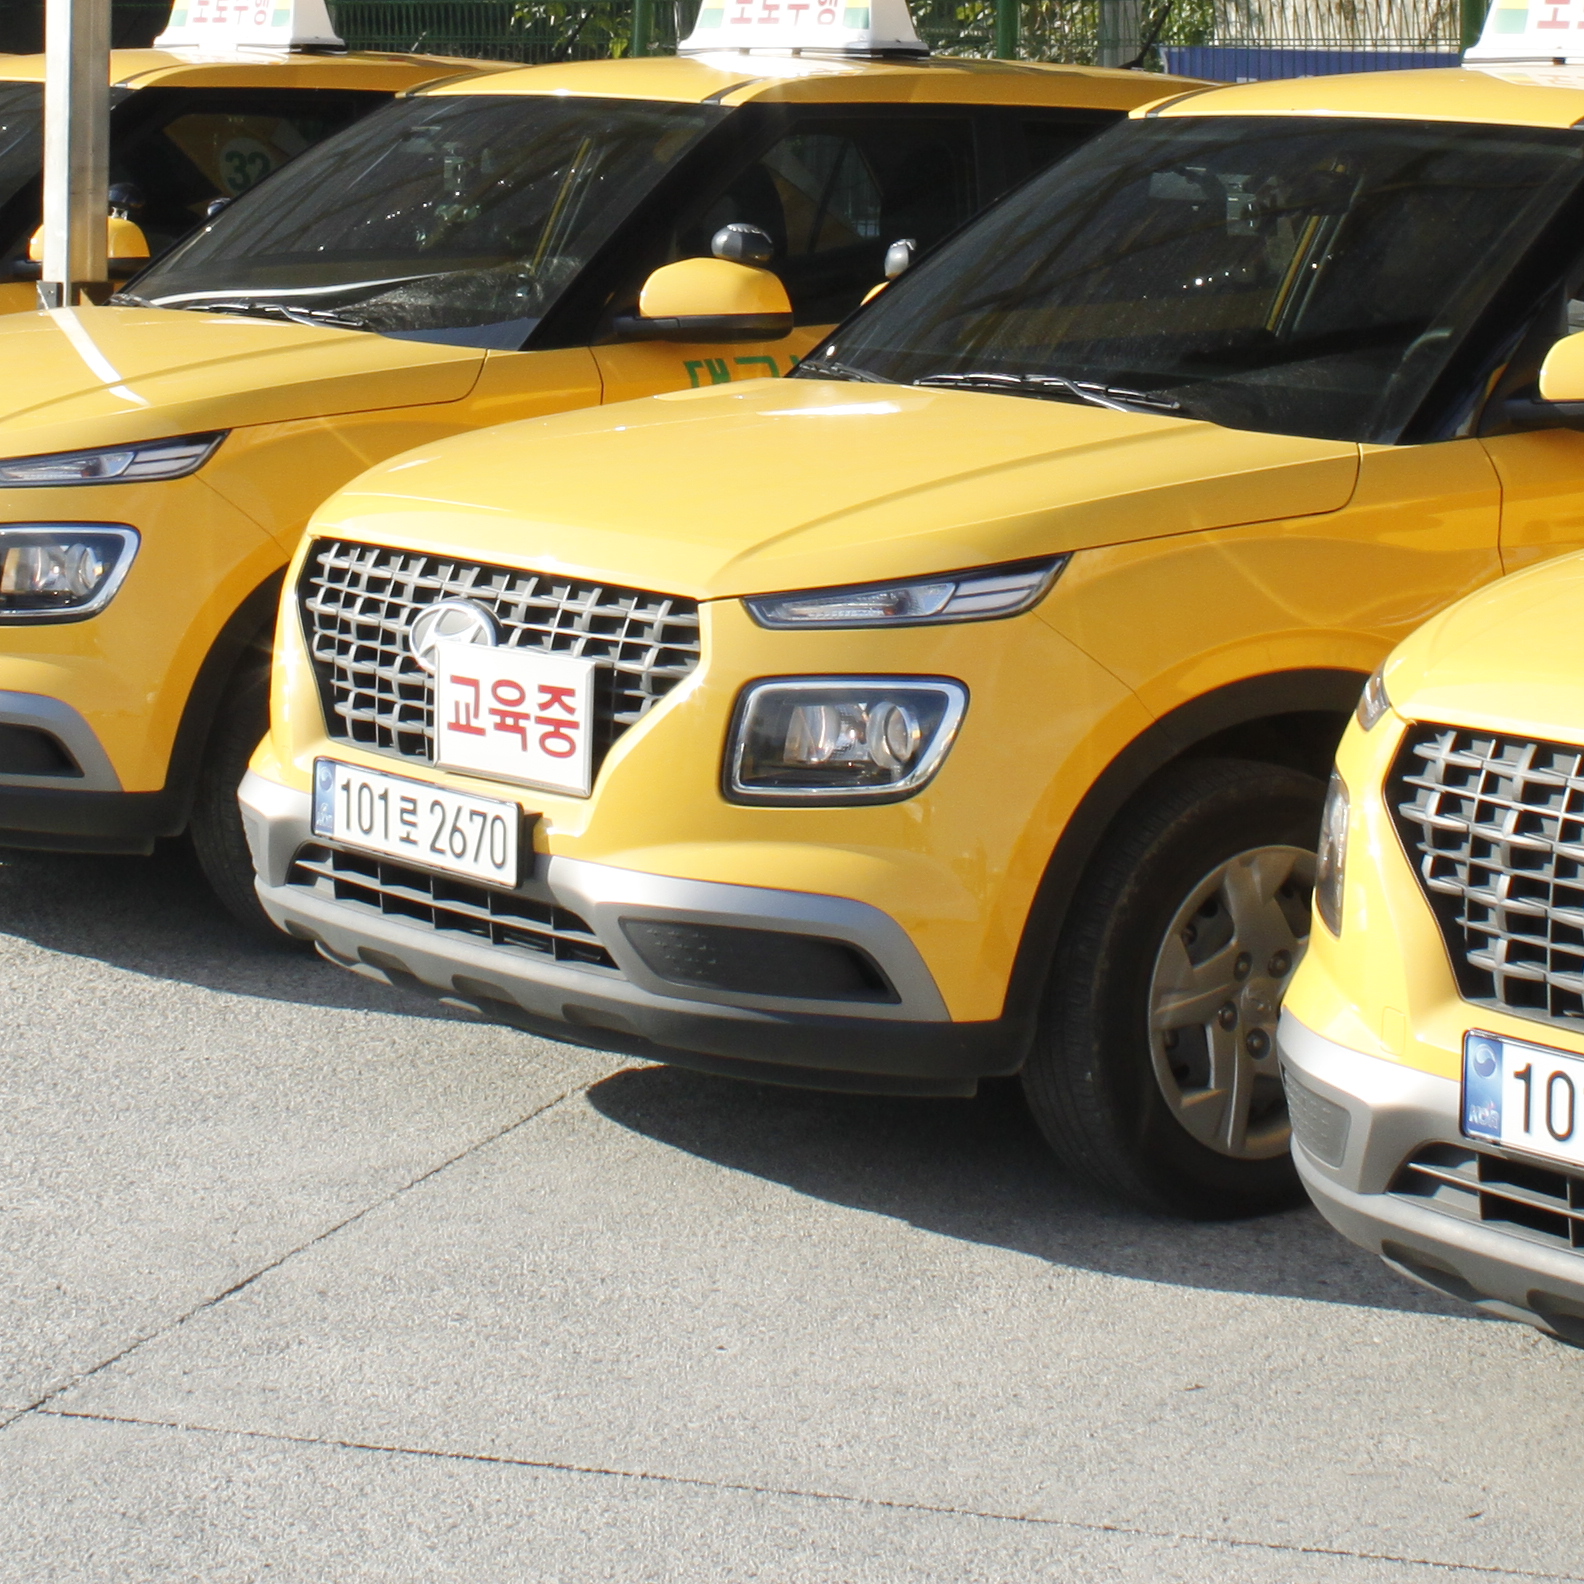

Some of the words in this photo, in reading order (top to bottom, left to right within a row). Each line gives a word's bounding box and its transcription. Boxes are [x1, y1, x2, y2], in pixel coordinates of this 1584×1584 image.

[447, 674, 580, 759] 교육중
[340, 777, 419, 845] 101로
[429, 799, 509, 870] 2670
